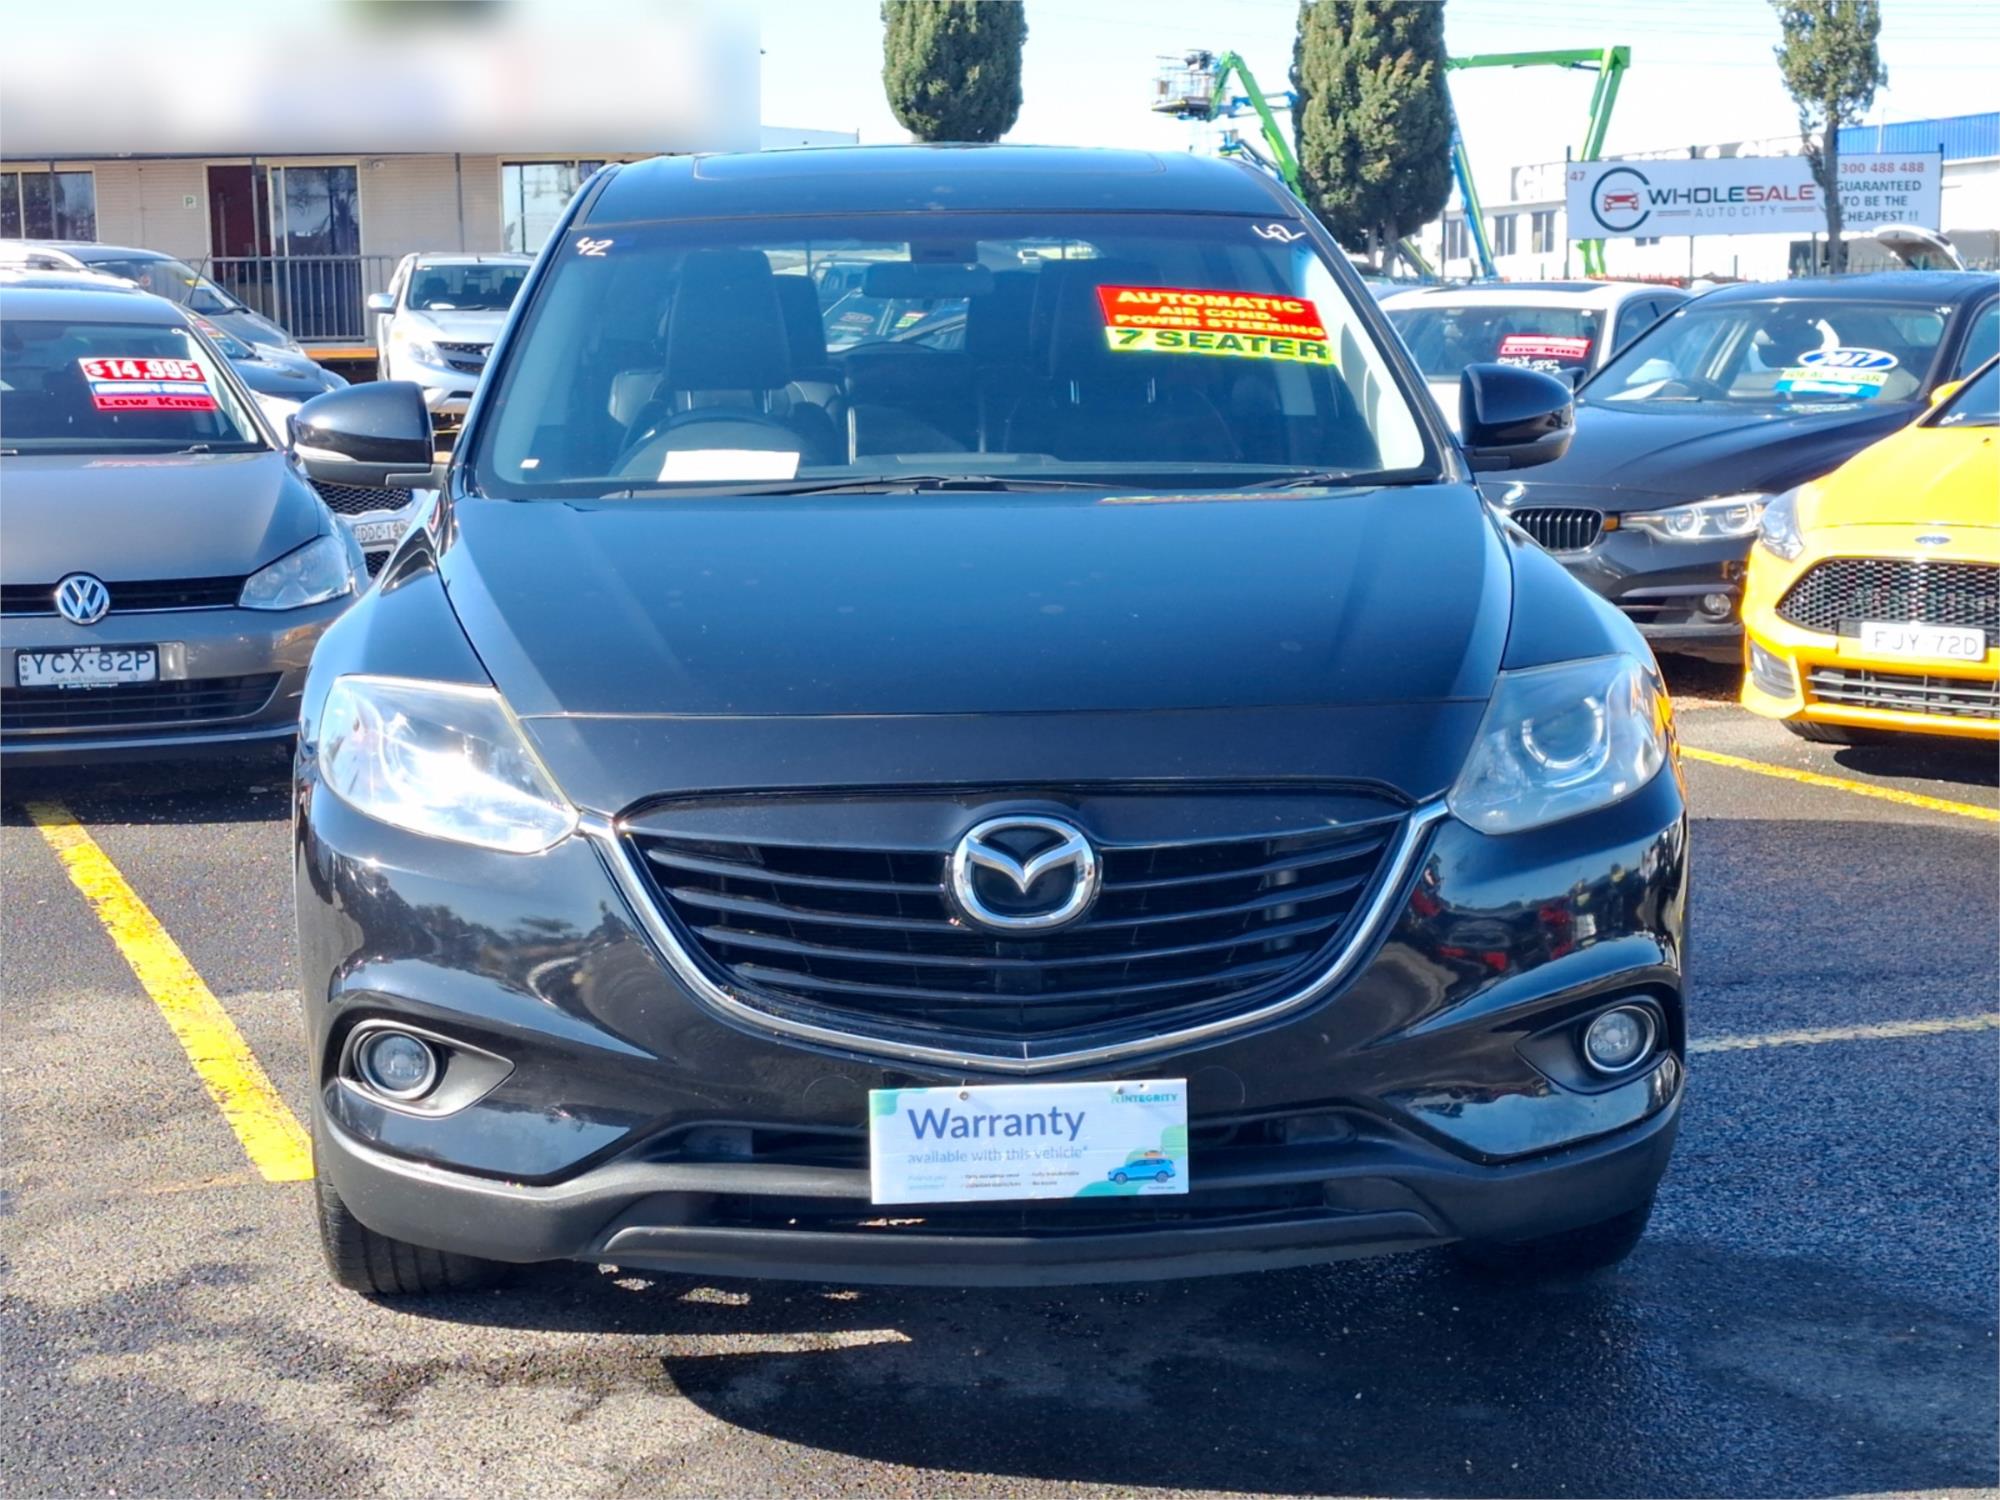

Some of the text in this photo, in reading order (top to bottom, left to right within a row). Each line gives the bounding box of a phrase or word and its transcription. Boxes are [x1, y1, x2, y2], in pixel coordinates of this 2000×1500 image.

[1870, 162, 1895, 173] 488
[1900, 162, 1925, 173] 488
[1569, 171, 1586, 182] 47
[1836, 180, 1922, 192] GUARANTEED
[1647, 184, 1817, 205] WHOLESALE
[1843, 195, 1908, 207] TO BE THE
[1694, 205, 1777, 218] AUTO CITY
[1117, 291, 1305, 313] AUTOMATIC
[1157, 306, 1200, 317] AIR
[1114, 314, 1325, 336] POWER STEERING
[1115, 329, 1328, 359] 7 SEATER
[85, 360, 200, 380] $14,995
[99, 396, 211, 408] Low Kms
[907, 1106, 1086, 1141] Warranty
[907, 1151, 968, 1164] available
[971, 1149, 1002, 1162] with
[1006, 1148, 1031, 1161] this
